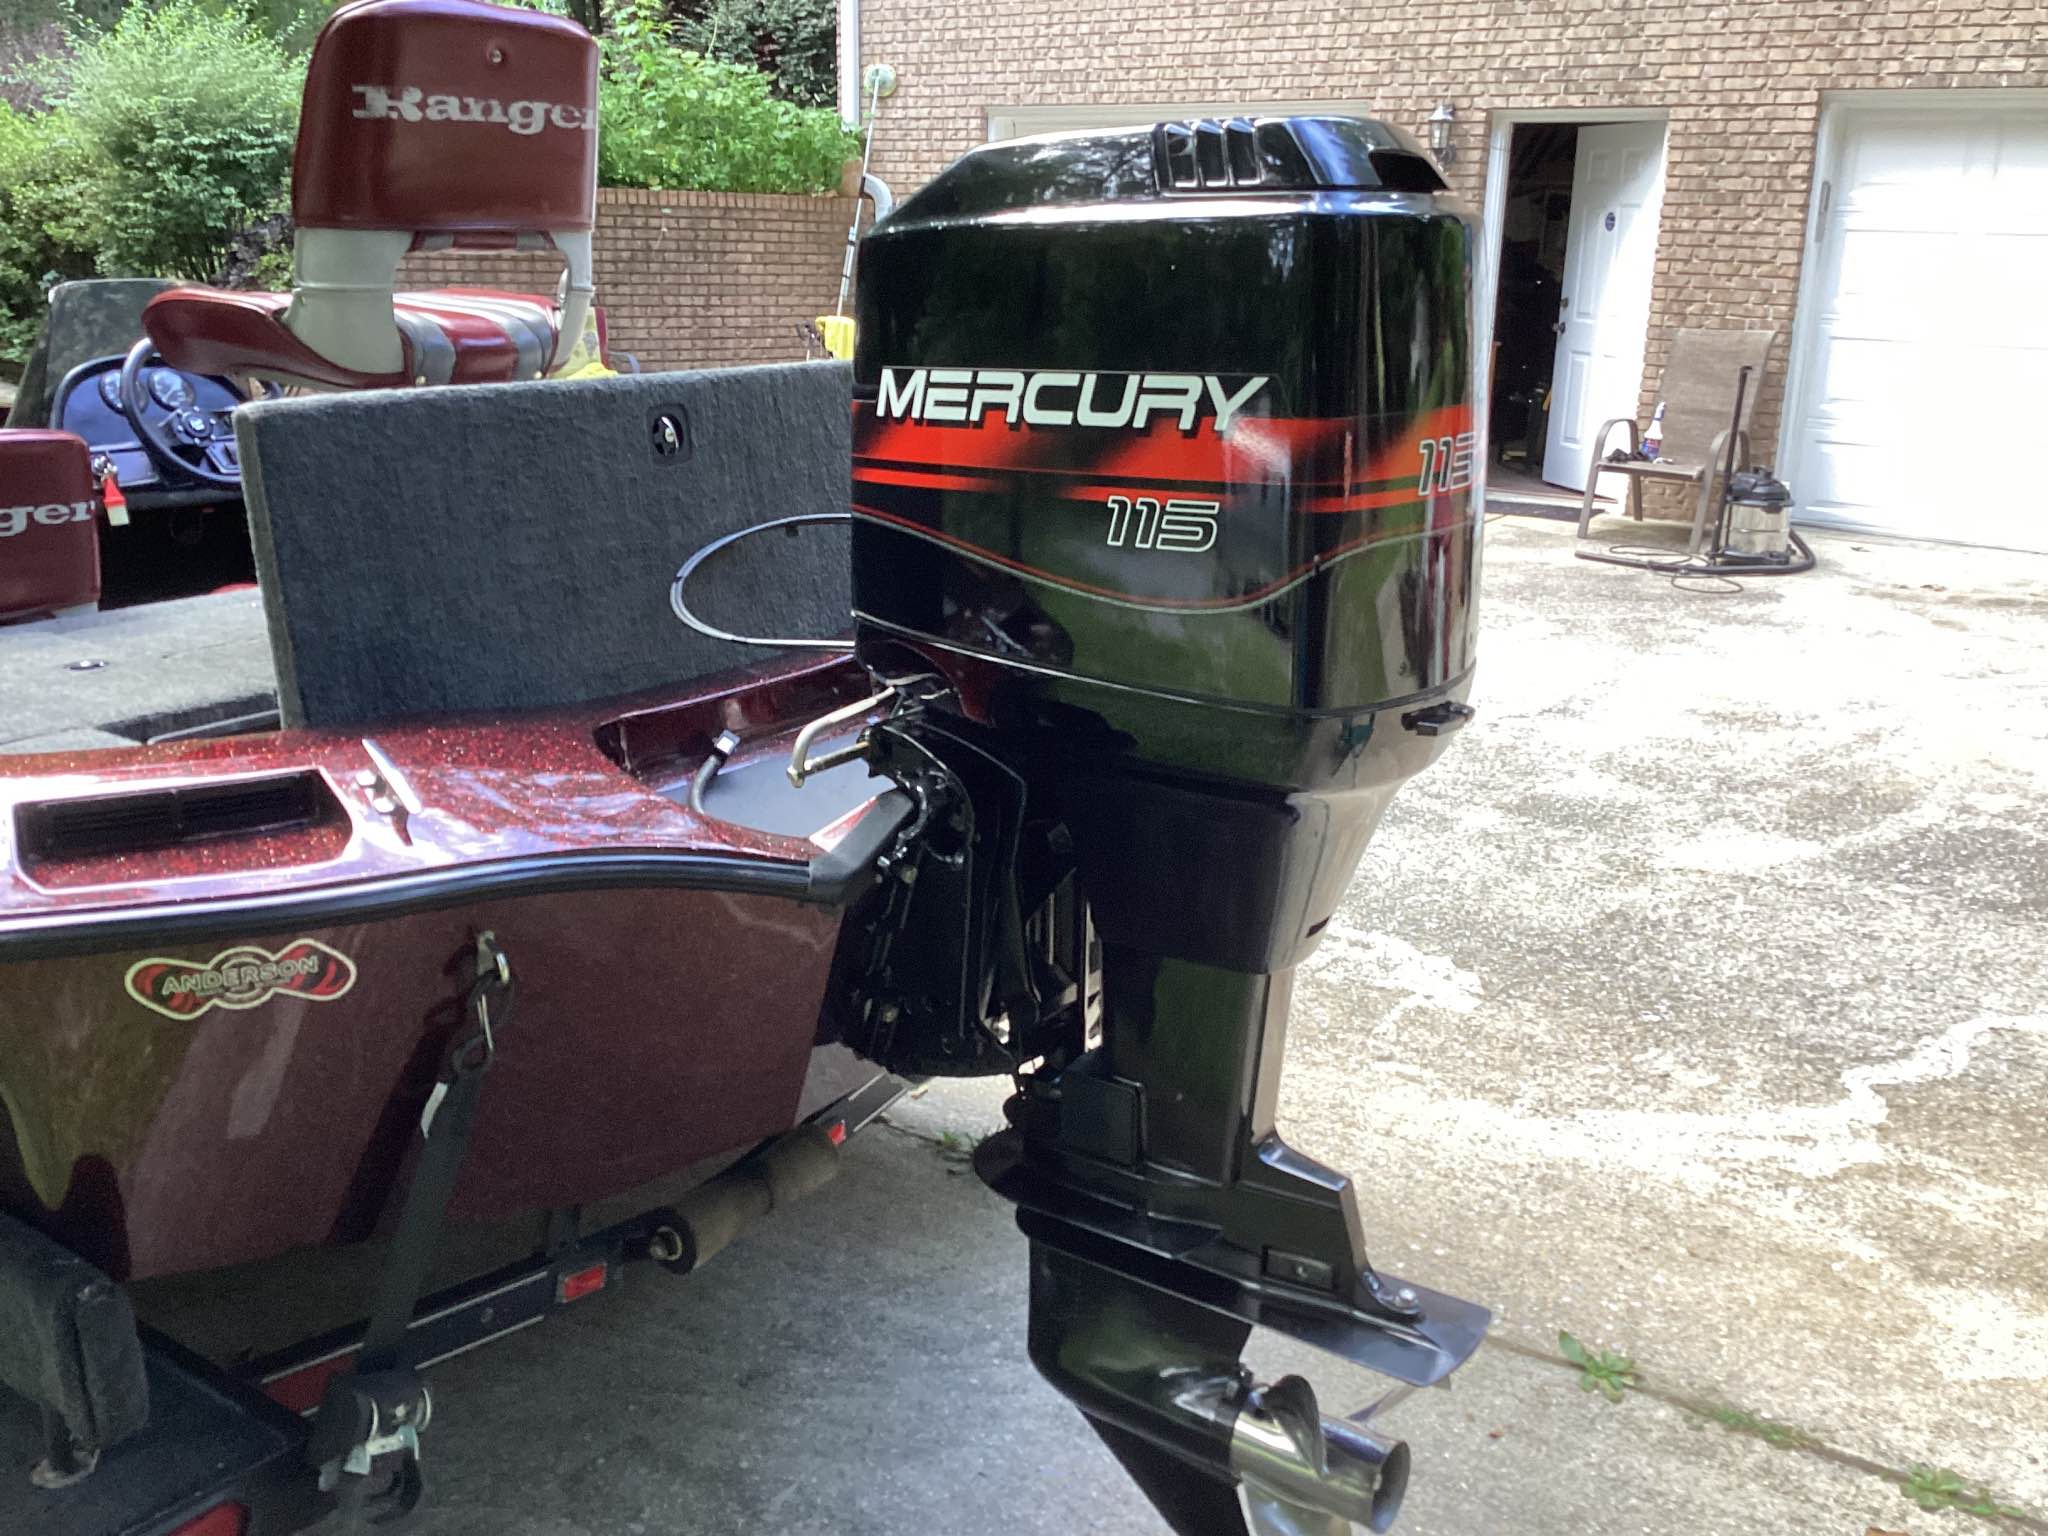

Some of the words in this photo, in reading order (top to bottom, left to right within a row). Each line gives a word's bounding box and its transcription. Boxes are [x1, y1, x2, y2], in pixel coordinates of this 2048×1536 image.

[876, 368, 1269, 431] MERCURY
[1418, 431, 1476, 496] 115
[1107, 496, 1220, 552] 115
[161, 955, 319, 996] ANDERSON
